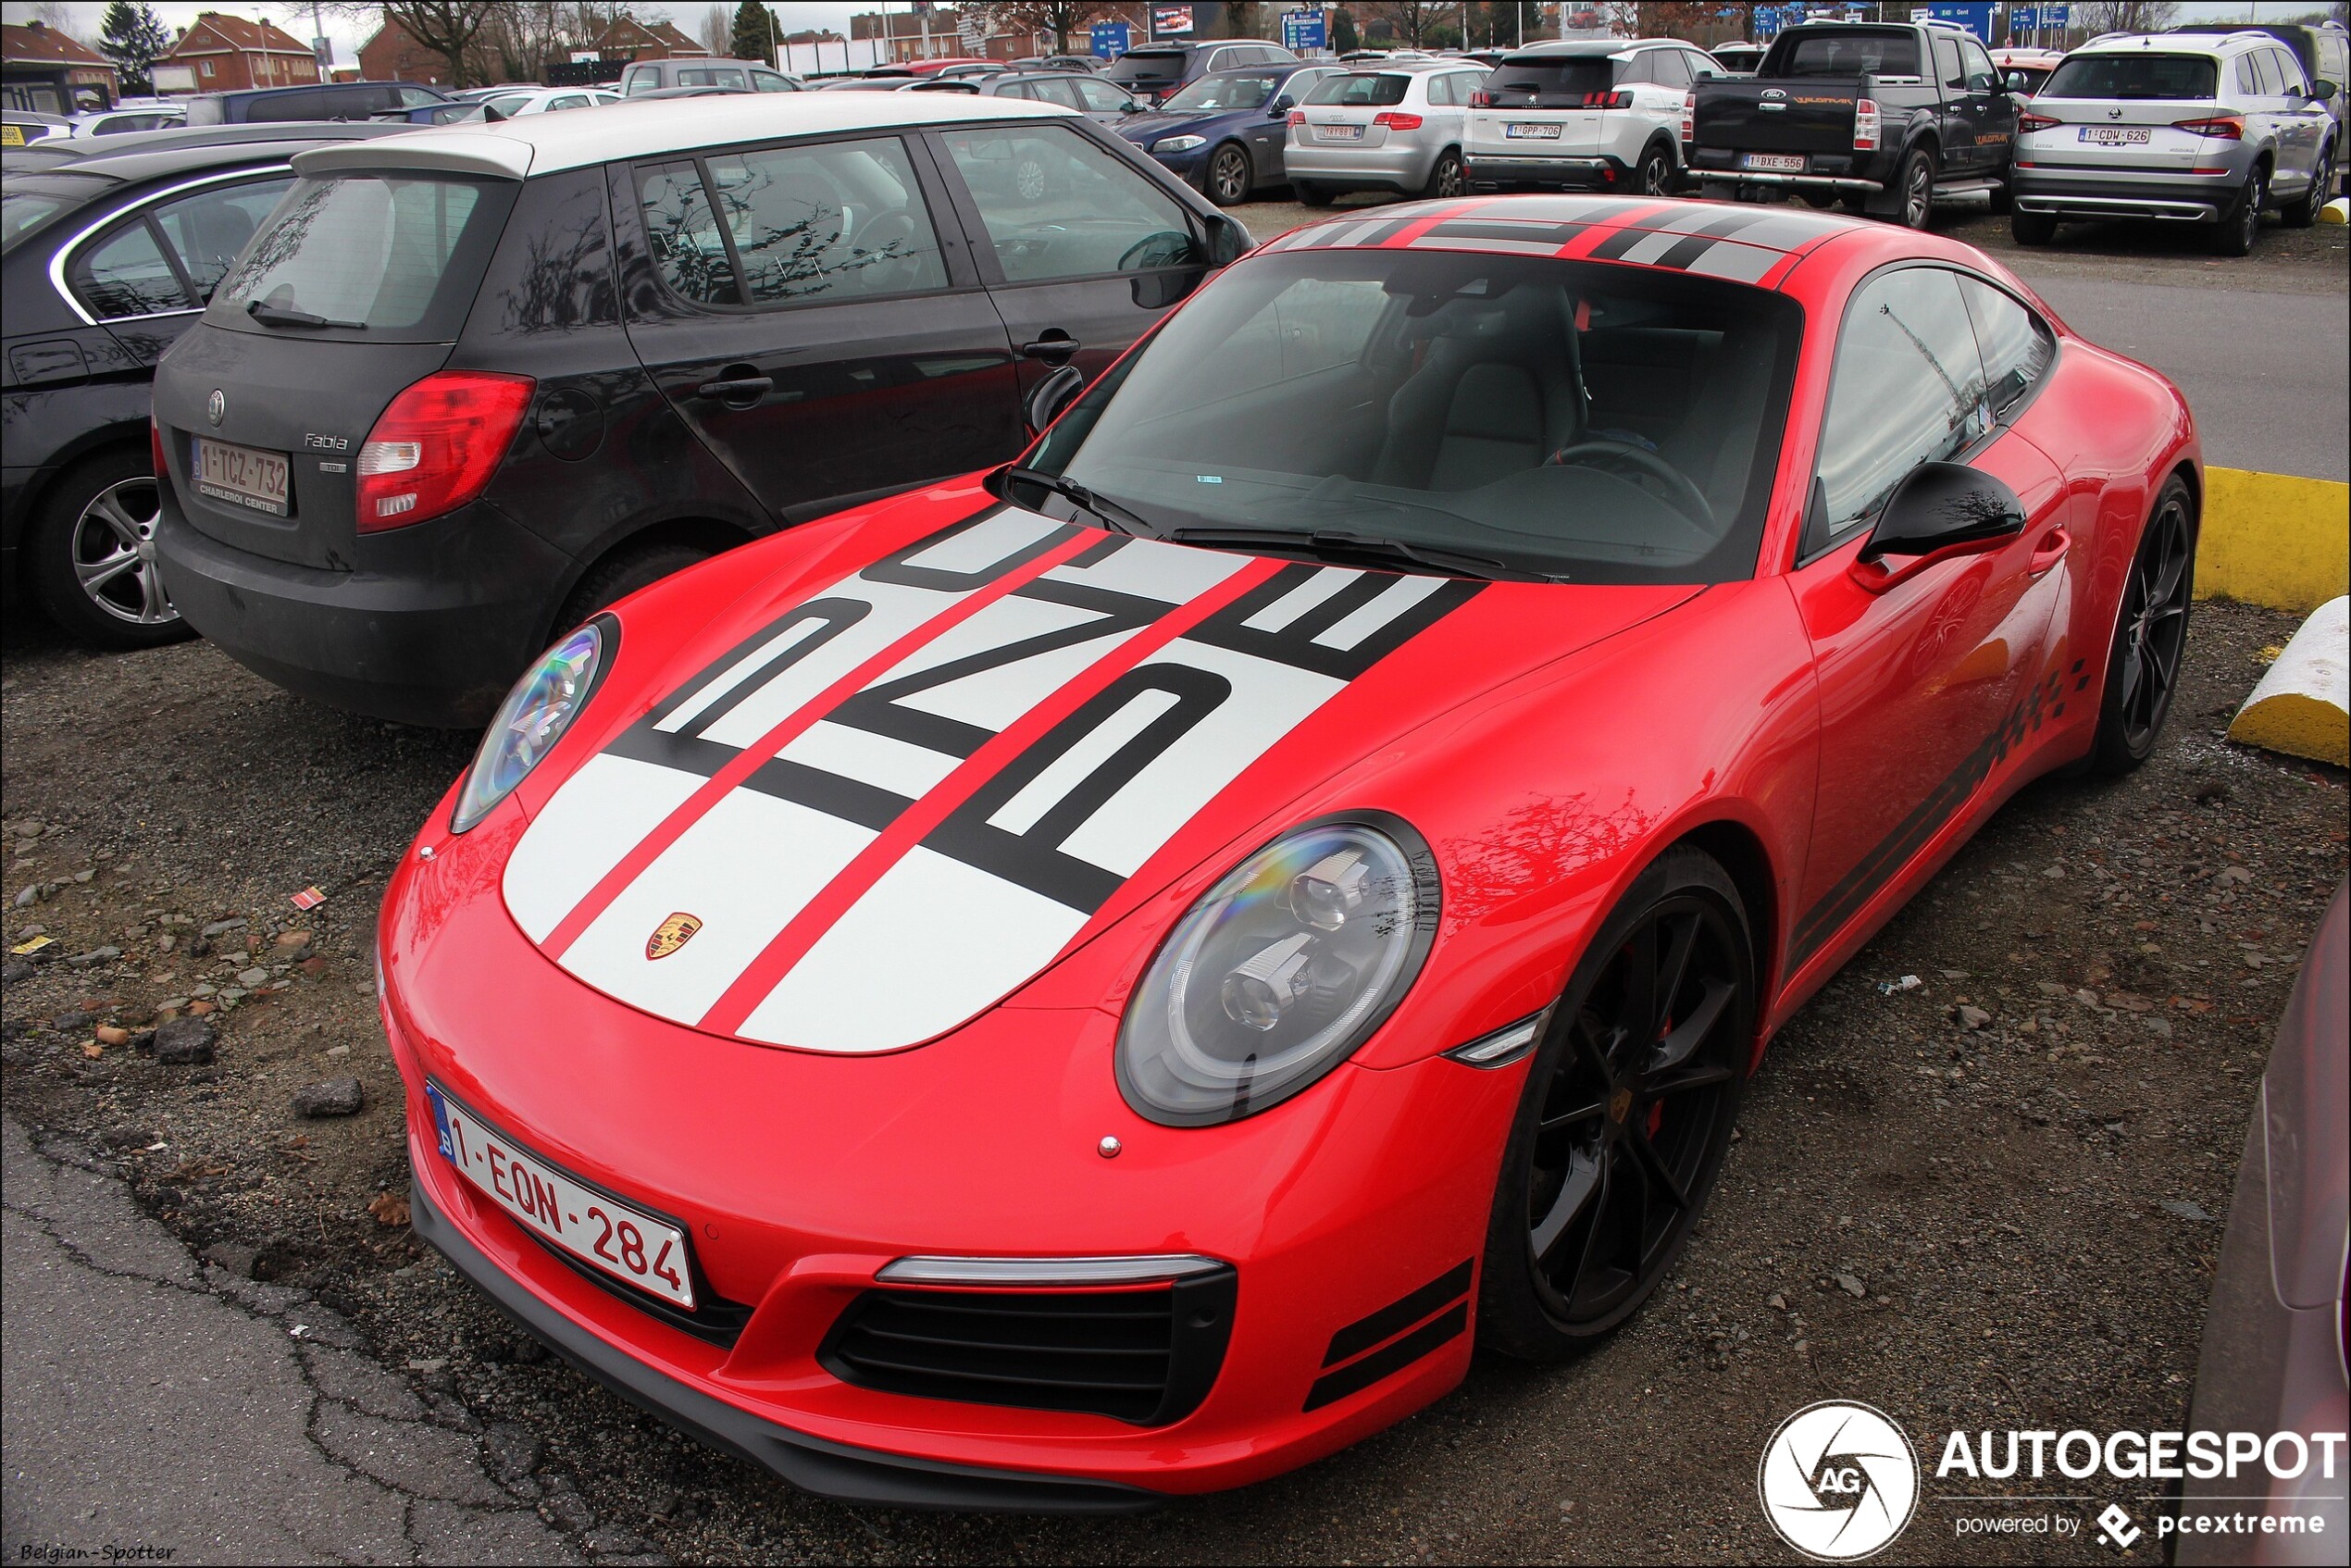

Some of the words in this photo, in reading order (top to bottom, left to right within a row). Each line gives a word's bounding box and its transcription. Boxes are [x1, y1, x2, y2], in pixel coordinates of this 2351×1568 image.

[2087, 129, 2148, 141] 1-CDW-626
[1750, 156, 1802, 168] 1-BXE-556
[305, 432, 348, 450] Fabia
[202, 445, 287, 497] 1-TCZ-732
[199, 484, 243, 504] CHARLEROI
[244, 497, 278, 514] CENTER
[440, 1130, 453, 1156] B
[452, 1117, 681, 1292] 1-EQN-284
